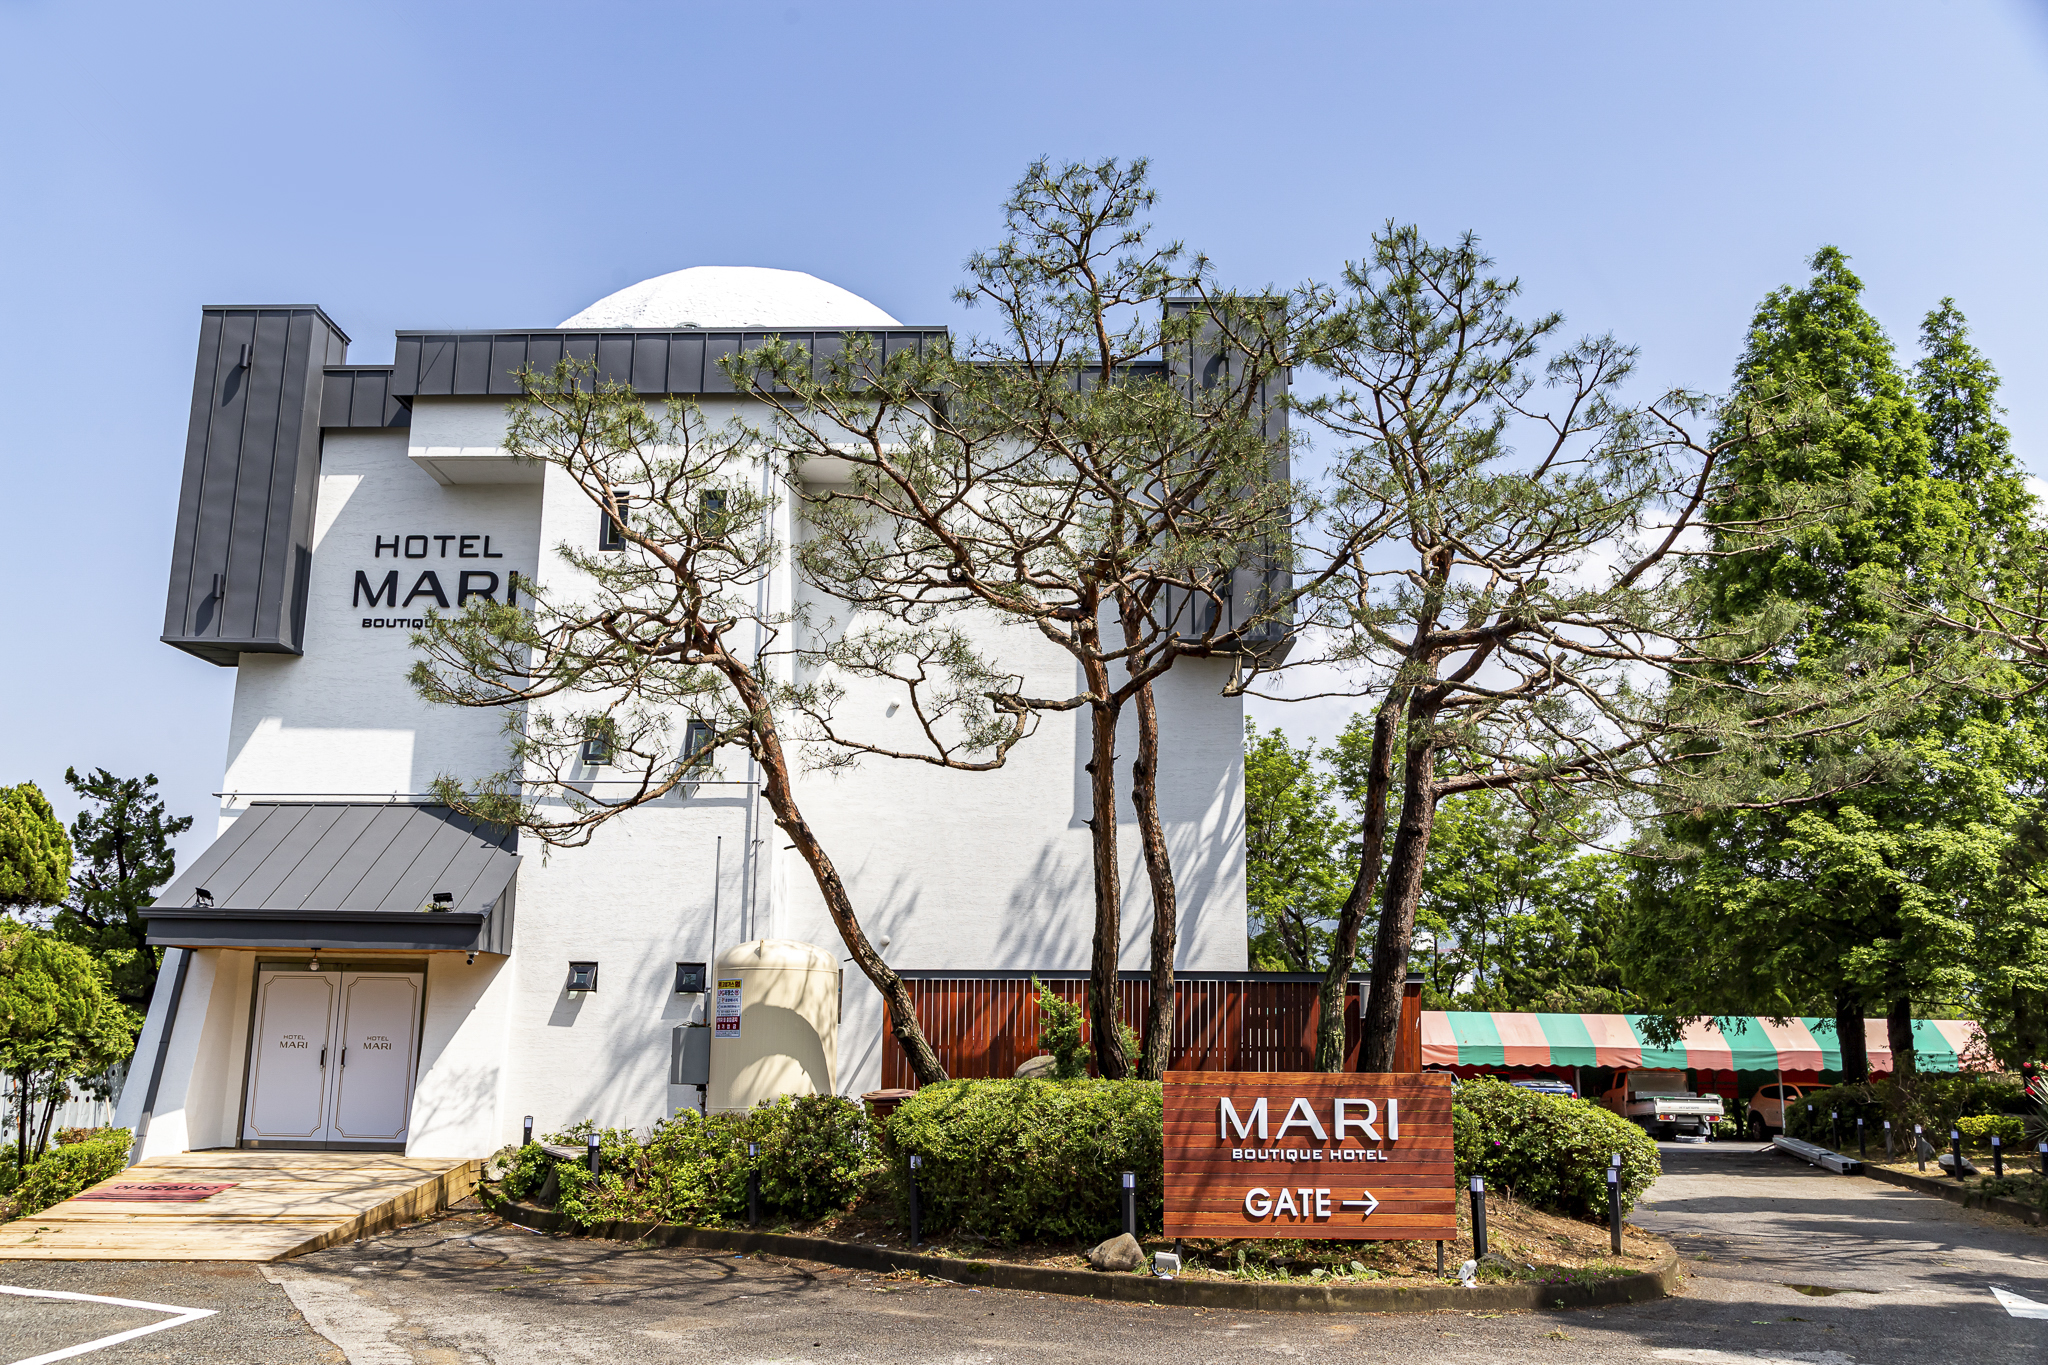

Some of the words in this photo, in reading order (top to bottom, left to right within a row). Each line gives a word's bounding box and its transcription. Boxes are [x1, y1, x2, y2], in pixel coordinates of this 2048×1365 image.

[375, 535, 503, 558] HOTEL
[353, 570, 519, 608] MARI
[279, 1041, 308, 1049] MARI
[363, 1042, 392, 1050] MARI
[1219, 1097, 1399, 1141] MARI
[1232, 1148, 1323, 1162] BOUTIQUE
[1330, 1149, 1388, 1162] HOTEL
[1245, 1188, 1332, 1217] GATE
